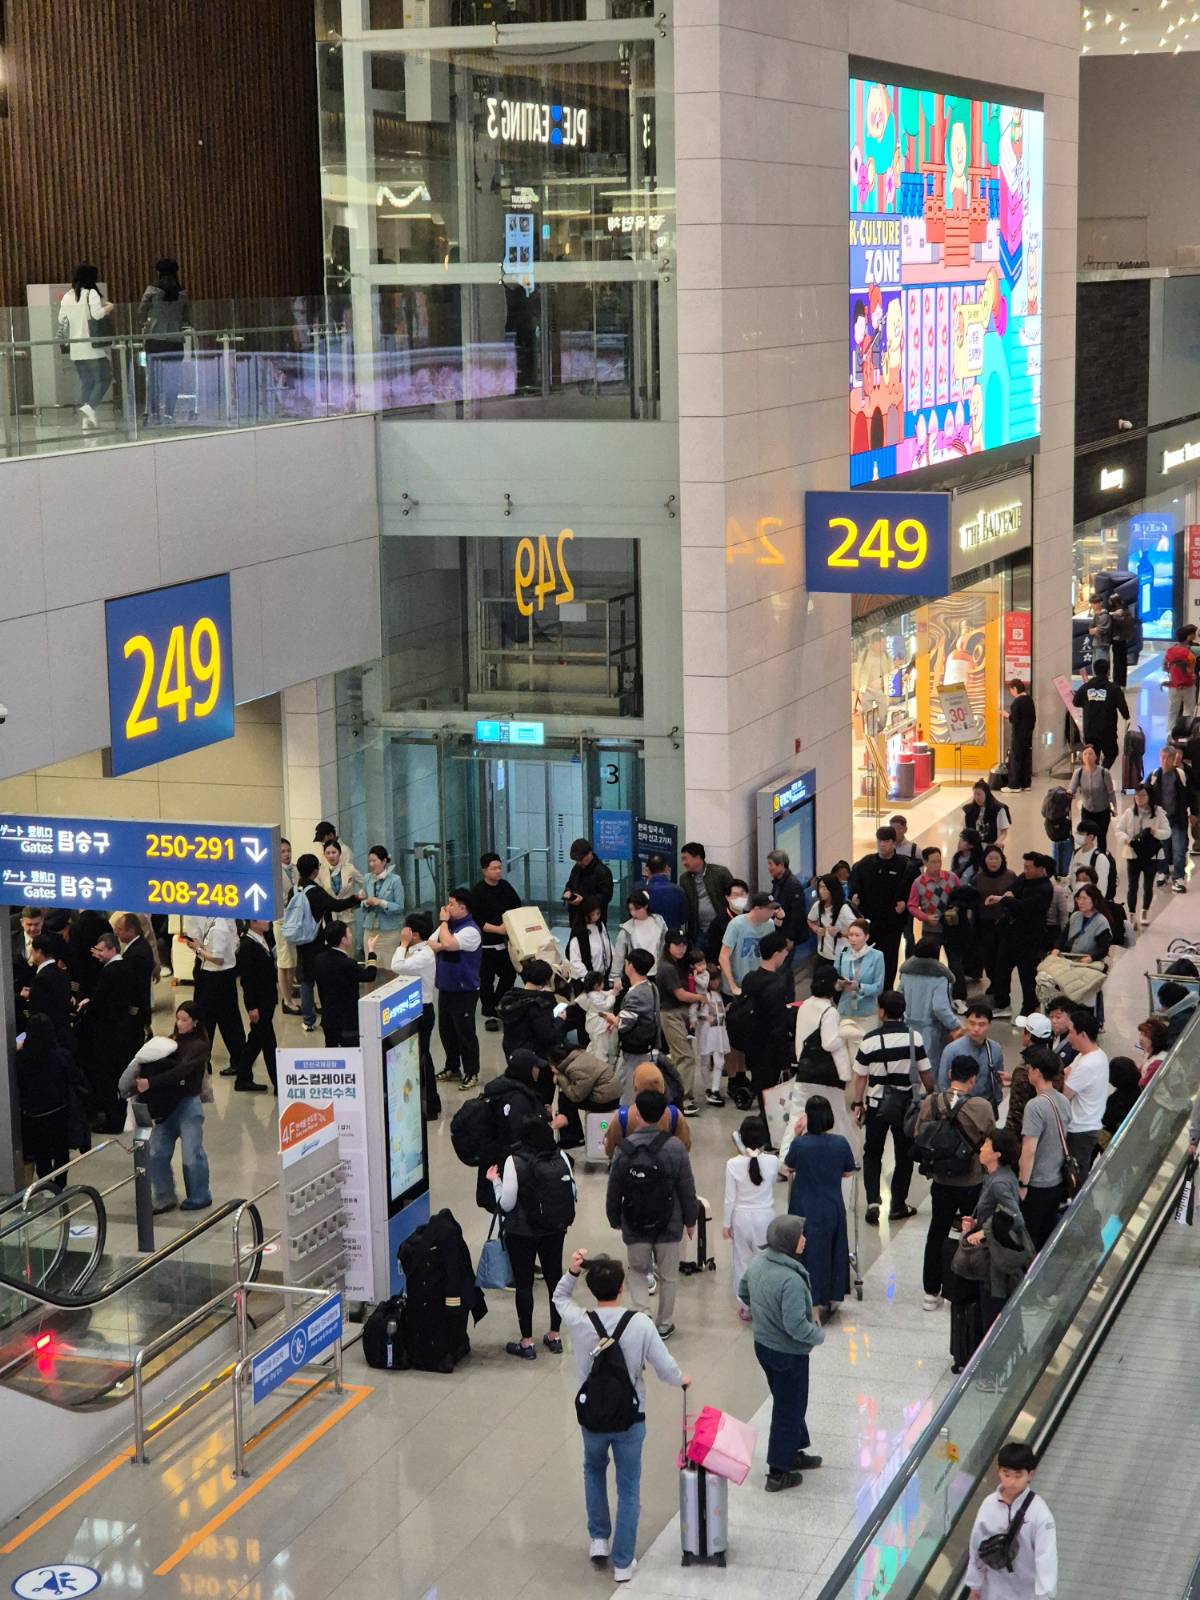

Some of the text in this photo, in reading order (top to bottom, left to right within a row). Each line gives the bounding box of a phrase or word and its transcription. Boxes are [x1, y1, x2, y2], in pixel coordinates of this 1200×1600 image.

[864, 249, 900, 284] ZONE
[826, 516, 928, 571] 249
[122, 616, 221, 740] 249
[605, 763, 619, 785] 3
[20, 841, 54, 854] Gates
[57, 830, 110, 854] 탑승구
[145, 834, 235, 861] 250-291
[23, 886, 57, 899] Gates
[60, 875, 113, 900] 탑승구
[147, 879, 240, 908] 208-248
[286, 1073, 356, 1085] 에스컬레이터
[287, 1086, 356, 1099] 4대 안전수칙
[282, 1121, 295, 1144] 4F
